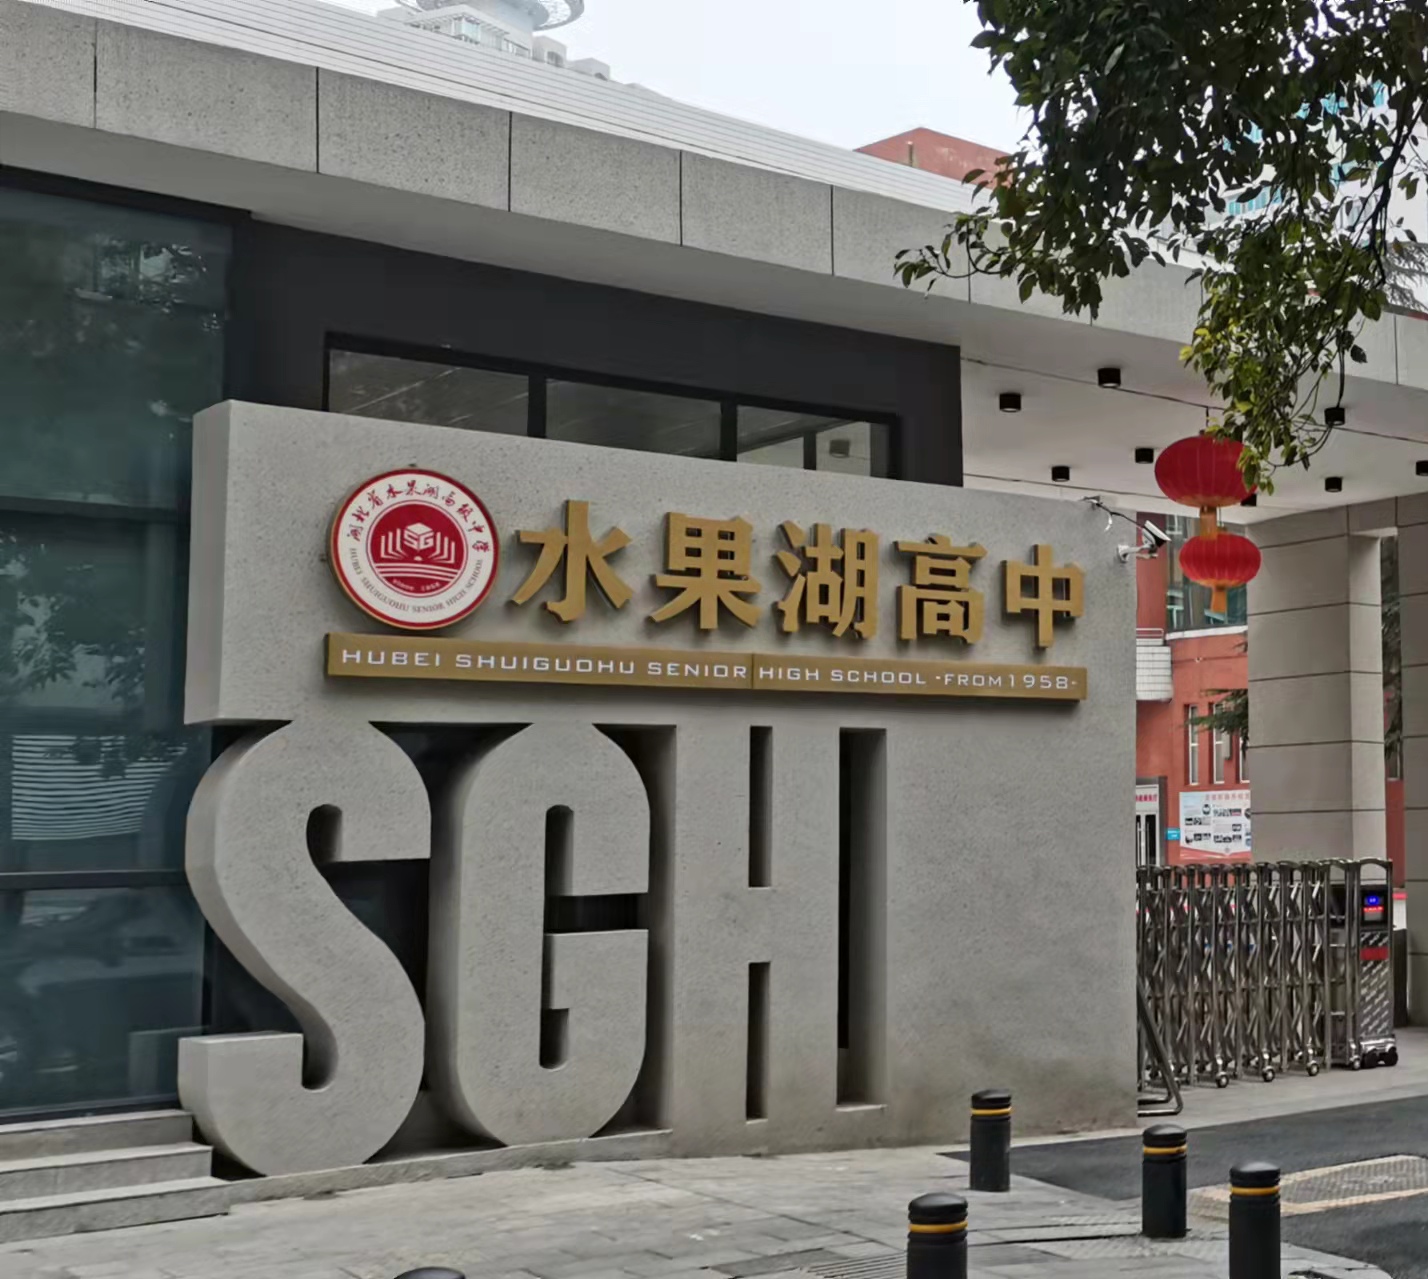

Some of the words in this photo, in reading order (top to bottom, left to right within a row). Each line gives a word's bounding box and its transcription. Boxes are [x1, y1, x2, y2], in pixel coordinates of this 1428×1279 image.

[511, 499, 1086, 649] 水果湖高中
[411, 602, 446, 614] SENIOR
[341, 649, 441, 667] HUBEI
[454, 653, 635, 675] SHUIGUOHU
[647, 662, 748, 679] SENIOR
[758, 666, 821, 681] HIGH
[830, 669, 927, 685] SCHOOL
